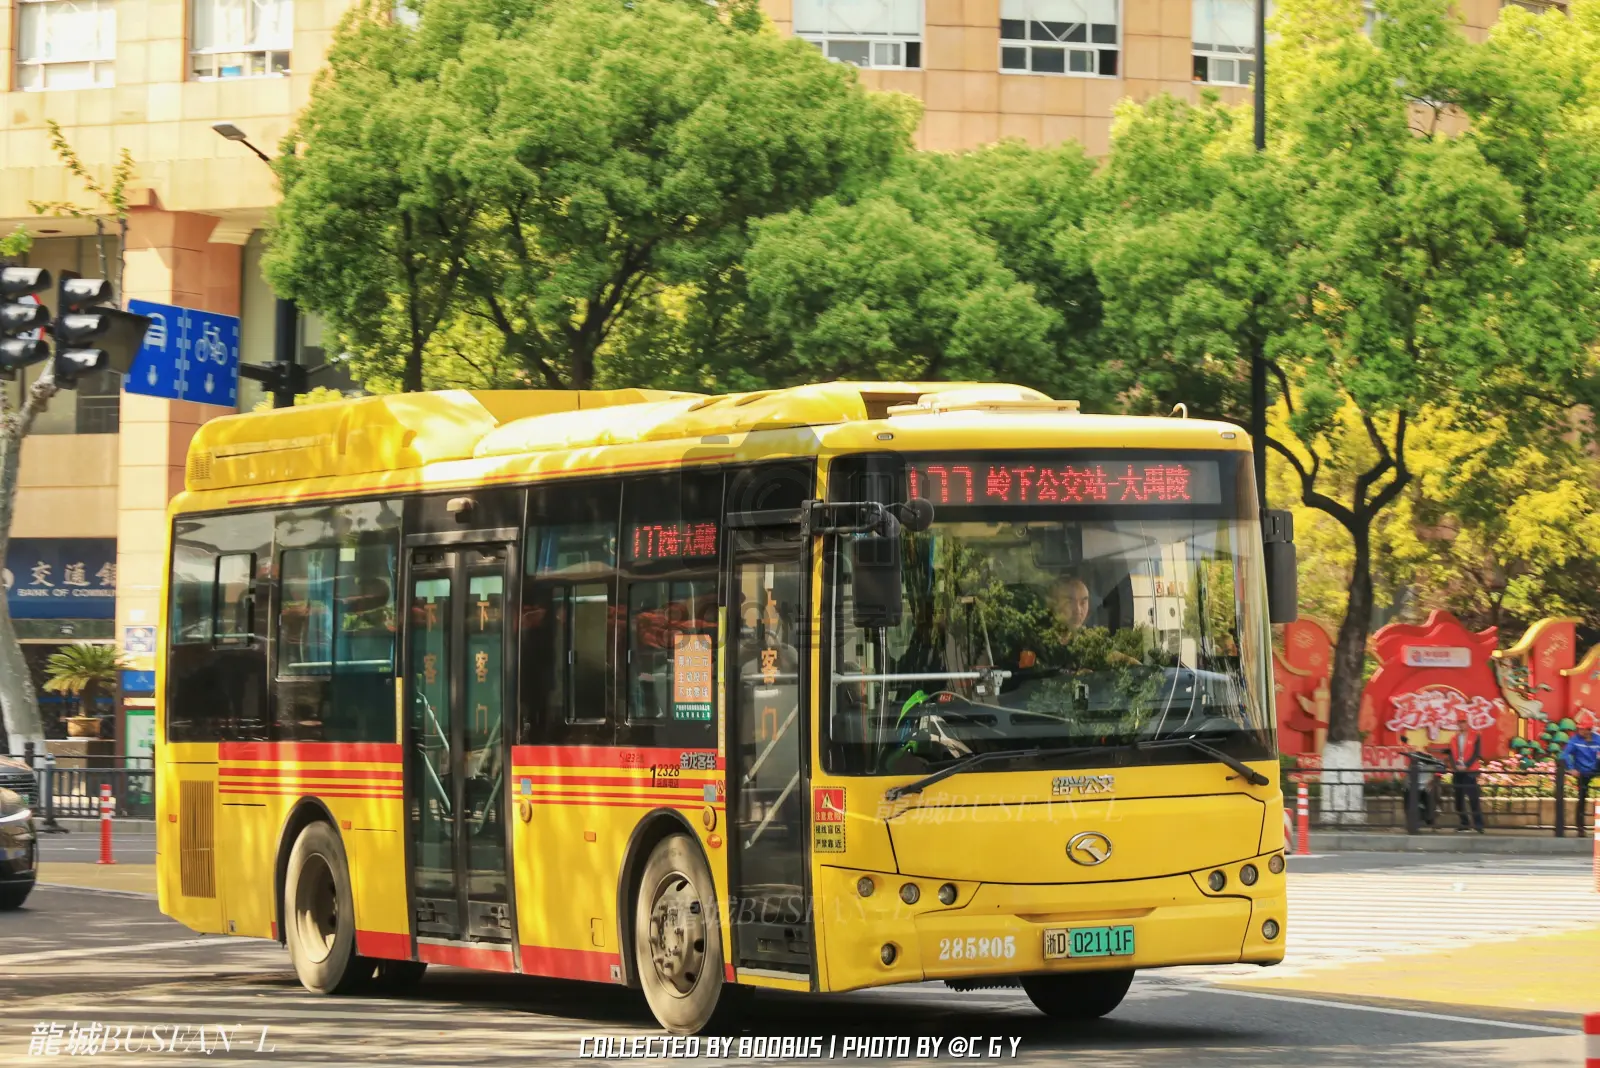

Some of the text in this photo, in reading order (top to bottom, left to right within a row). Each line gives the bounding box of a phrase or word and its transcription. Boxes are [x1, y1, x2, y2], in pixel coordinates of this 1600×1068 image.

[909, 465, 973, 504] 177
[17, 588, 49, 597] BANK
[52, 588, 69, 597] OF
[679, 750, 717, 770] 金龙客车
[1052, 774, 1116, 796] 绍兴公交
[939, 935, 1016, 960] 285805
